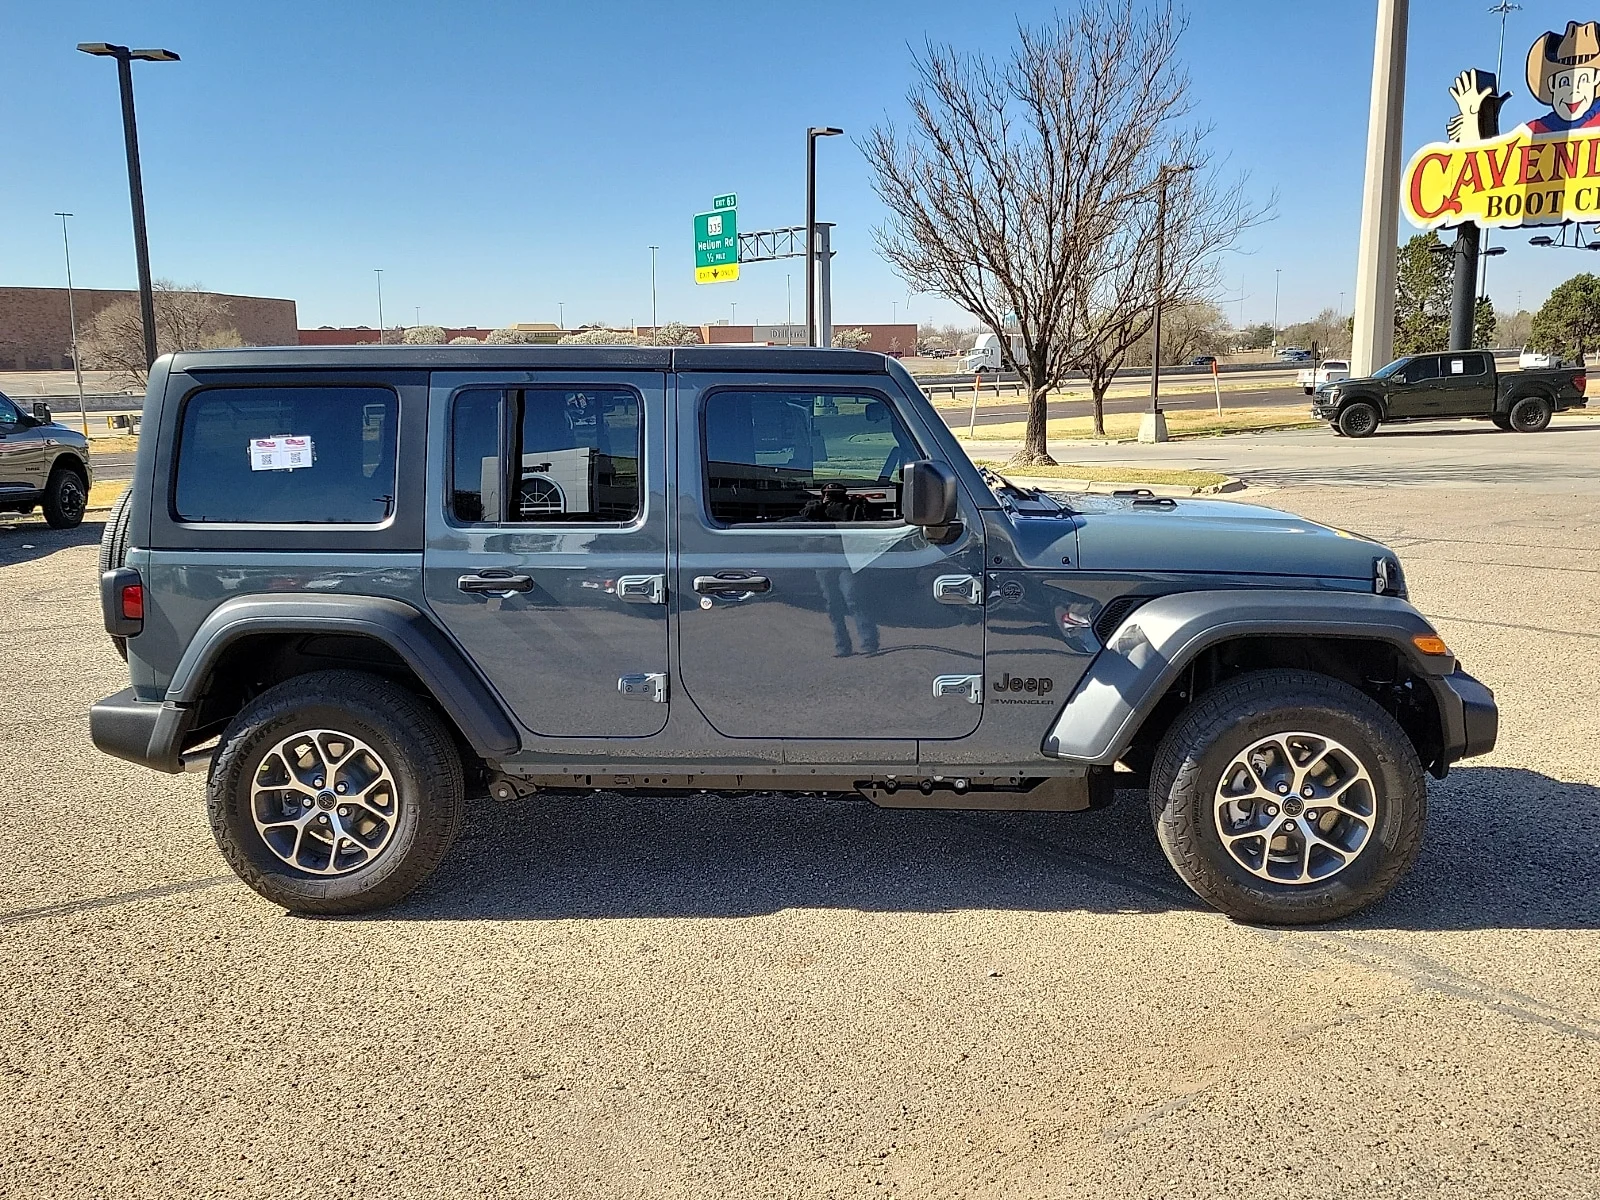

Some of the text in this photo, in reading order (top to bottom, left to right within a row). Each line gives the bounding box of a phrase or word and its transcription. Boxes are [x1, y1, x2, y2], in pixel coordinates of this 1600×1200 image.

[726, 196, 735, 206] 63
[1485, 190, 1565, 218] BOOT
[709, 223, 721, 233] 335
[697, 237, 734, 251] Helium Rd
[992, 672, 1054, 697] Jeep
